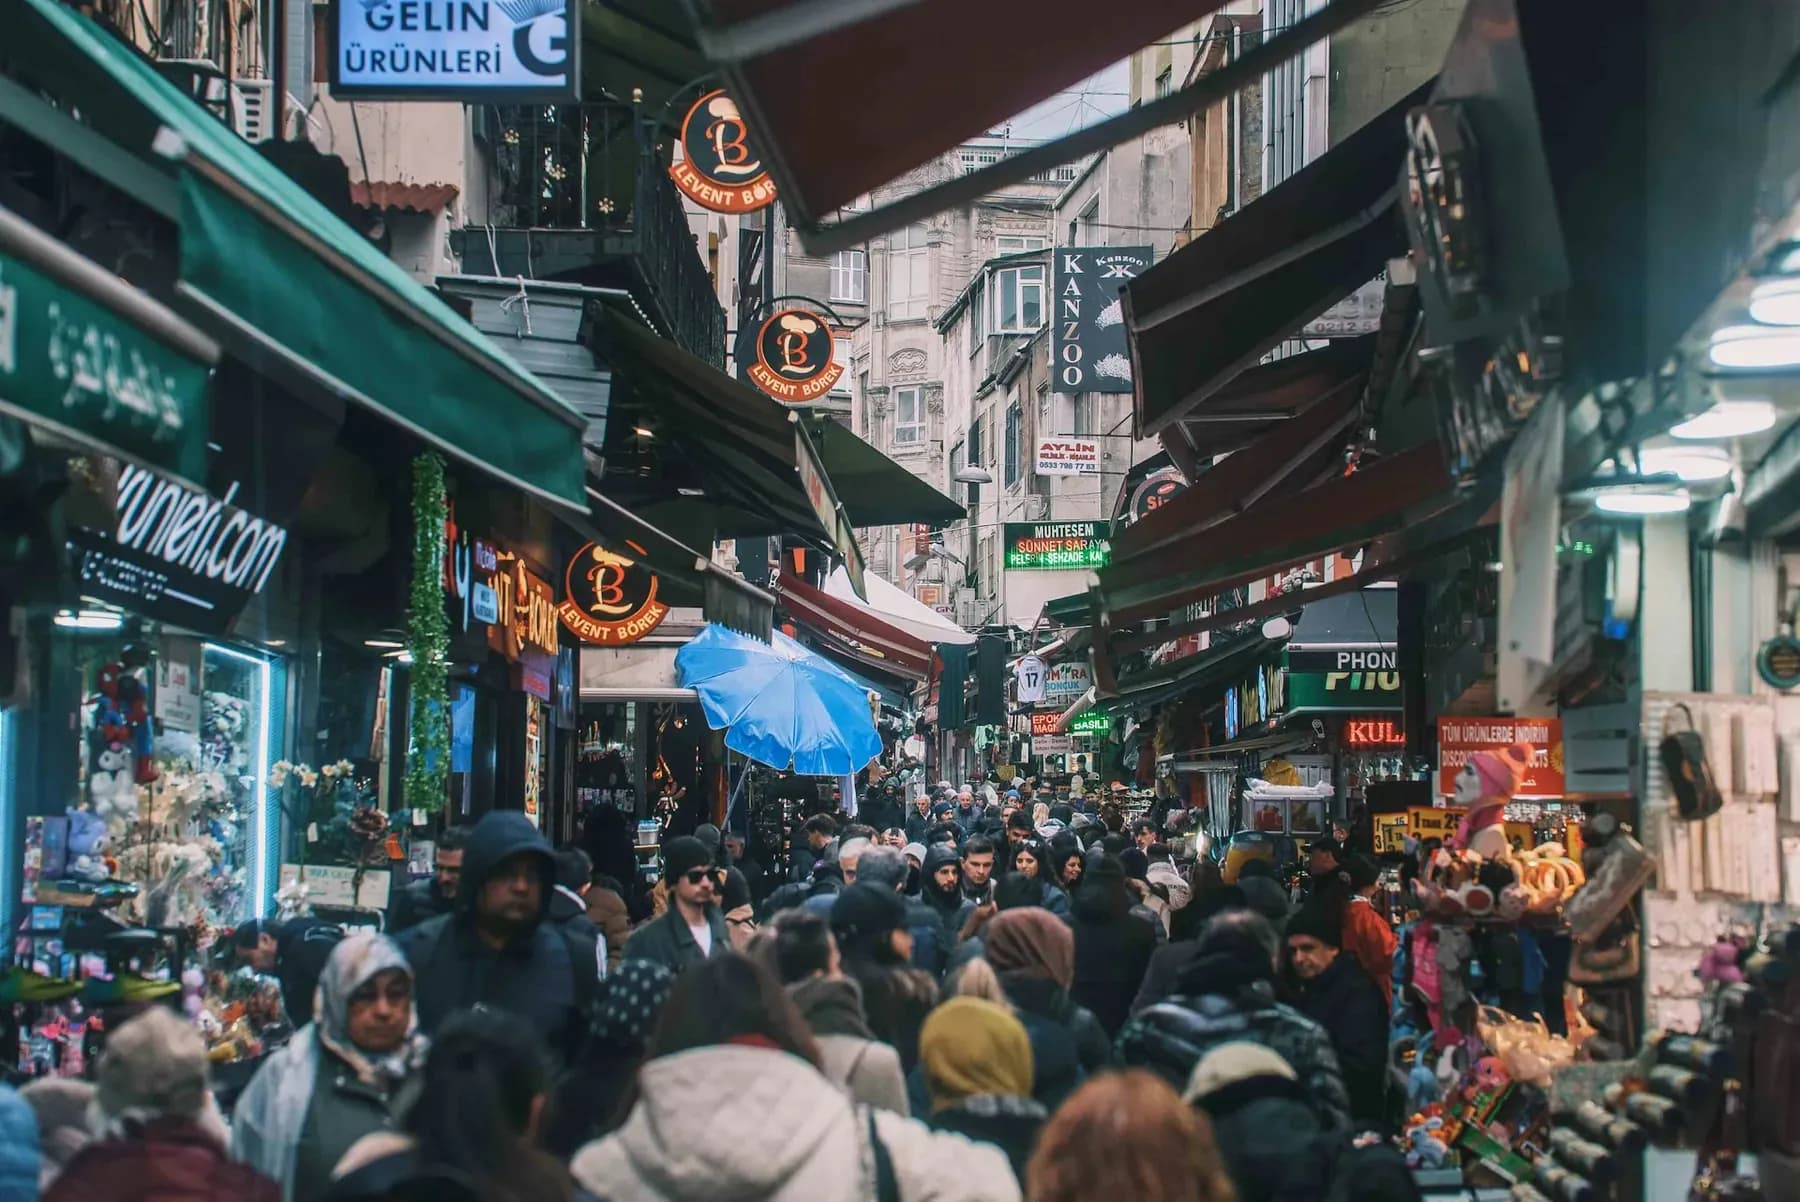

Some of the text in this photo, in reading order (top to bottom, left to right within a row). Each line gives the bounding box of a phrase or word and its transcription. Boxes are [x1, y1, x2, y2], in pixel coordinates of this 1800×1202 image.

[345, 42, 501, 73] ÜRÜNLERİ
[675, 164, 735, 206] LEVENT
[1095, 255, 1144, 267] Kanzoo
[1062, 254, 1084, 386] KANZOO
[752, 364, 840, 396] LEVENT BÖREK
[1040, 443, 1095, 452] AYLİN
[1066, 539, 1105, 551] SARAY
[560, 603, 663, 640] LEVENT BÖREK
[1025, 673, 1038, 688] 17
[1350, 722, 1404, 742] KUL
[1442, 723, 1549, 743] TÜM ÜRÜNLERDE İNDİRİM
